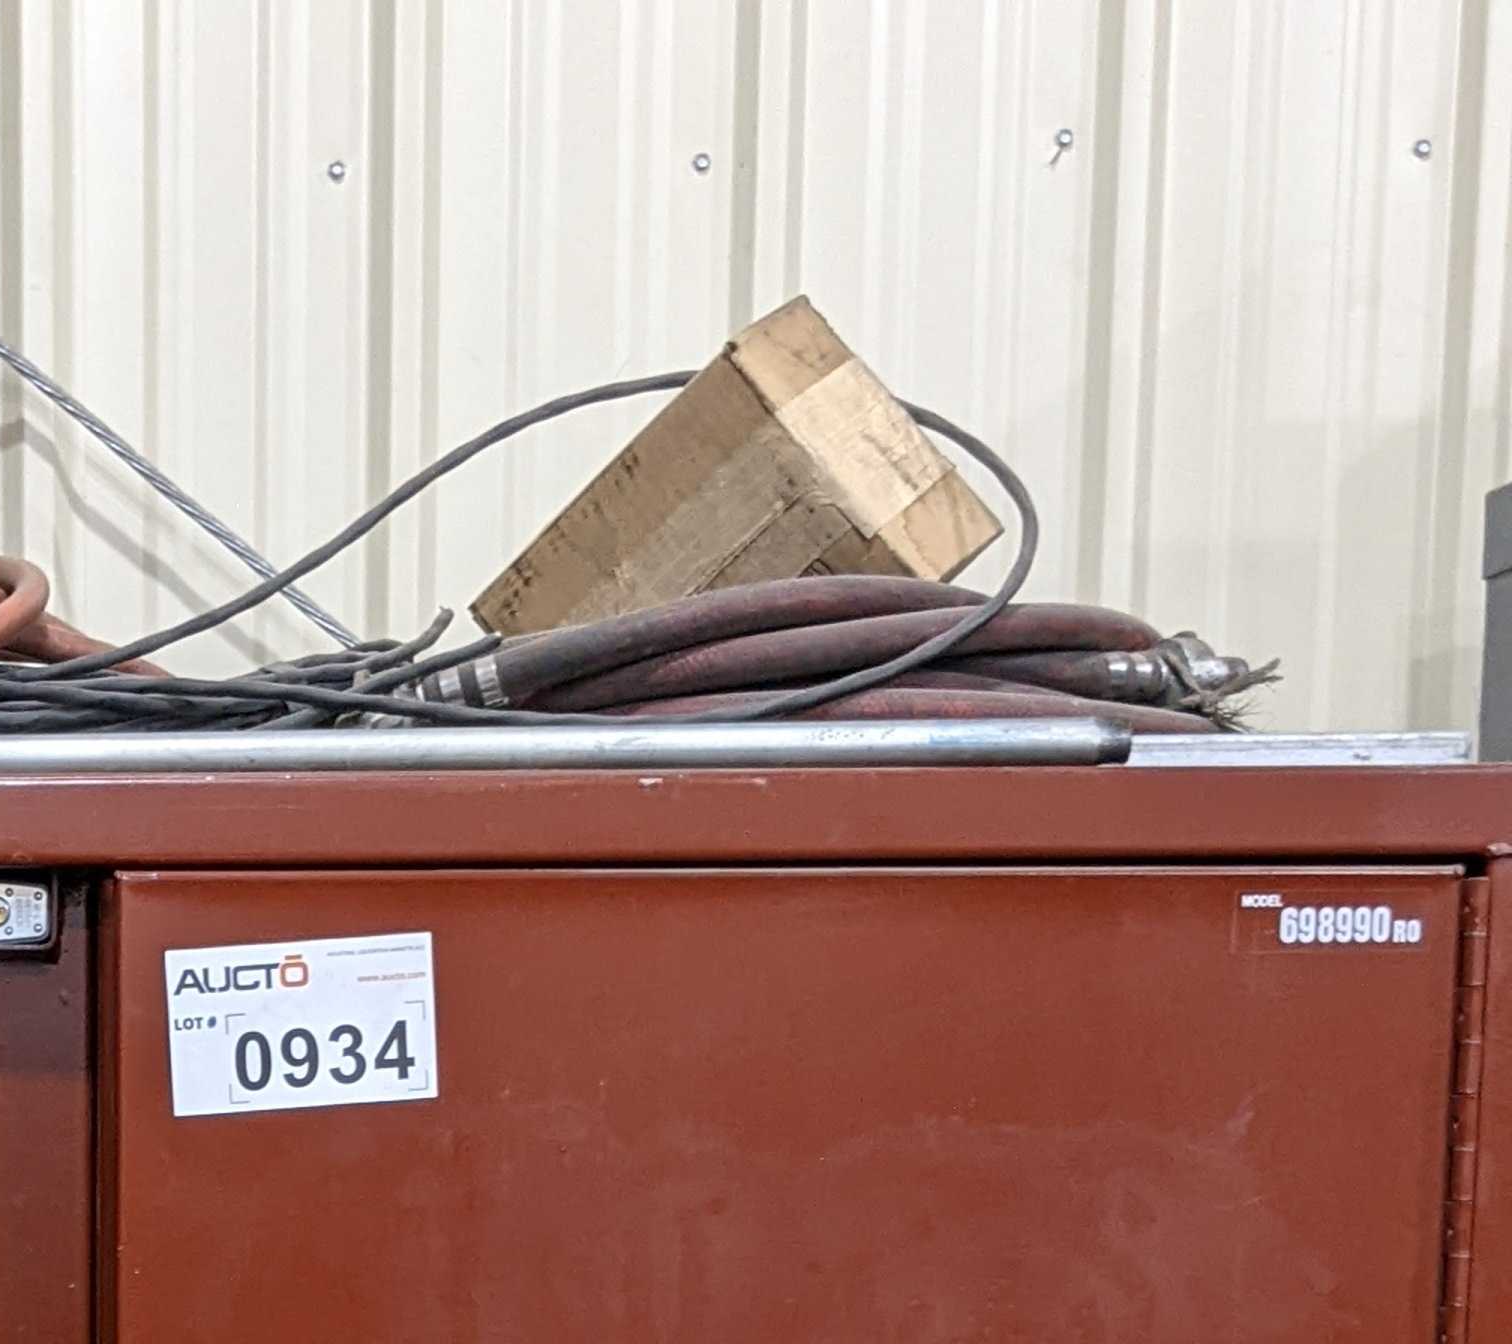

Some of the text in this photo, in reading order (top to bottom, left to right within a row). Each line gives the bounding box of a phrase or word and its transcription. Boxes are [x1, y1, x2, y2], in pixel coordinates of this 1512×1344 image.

[1241, 894, 1283, 907] MODEL
[1279, 906, 1391, 943] 698990
[174, 1017, 203, 1031] LOT
[235, 1019, 415, 1091] 0934
